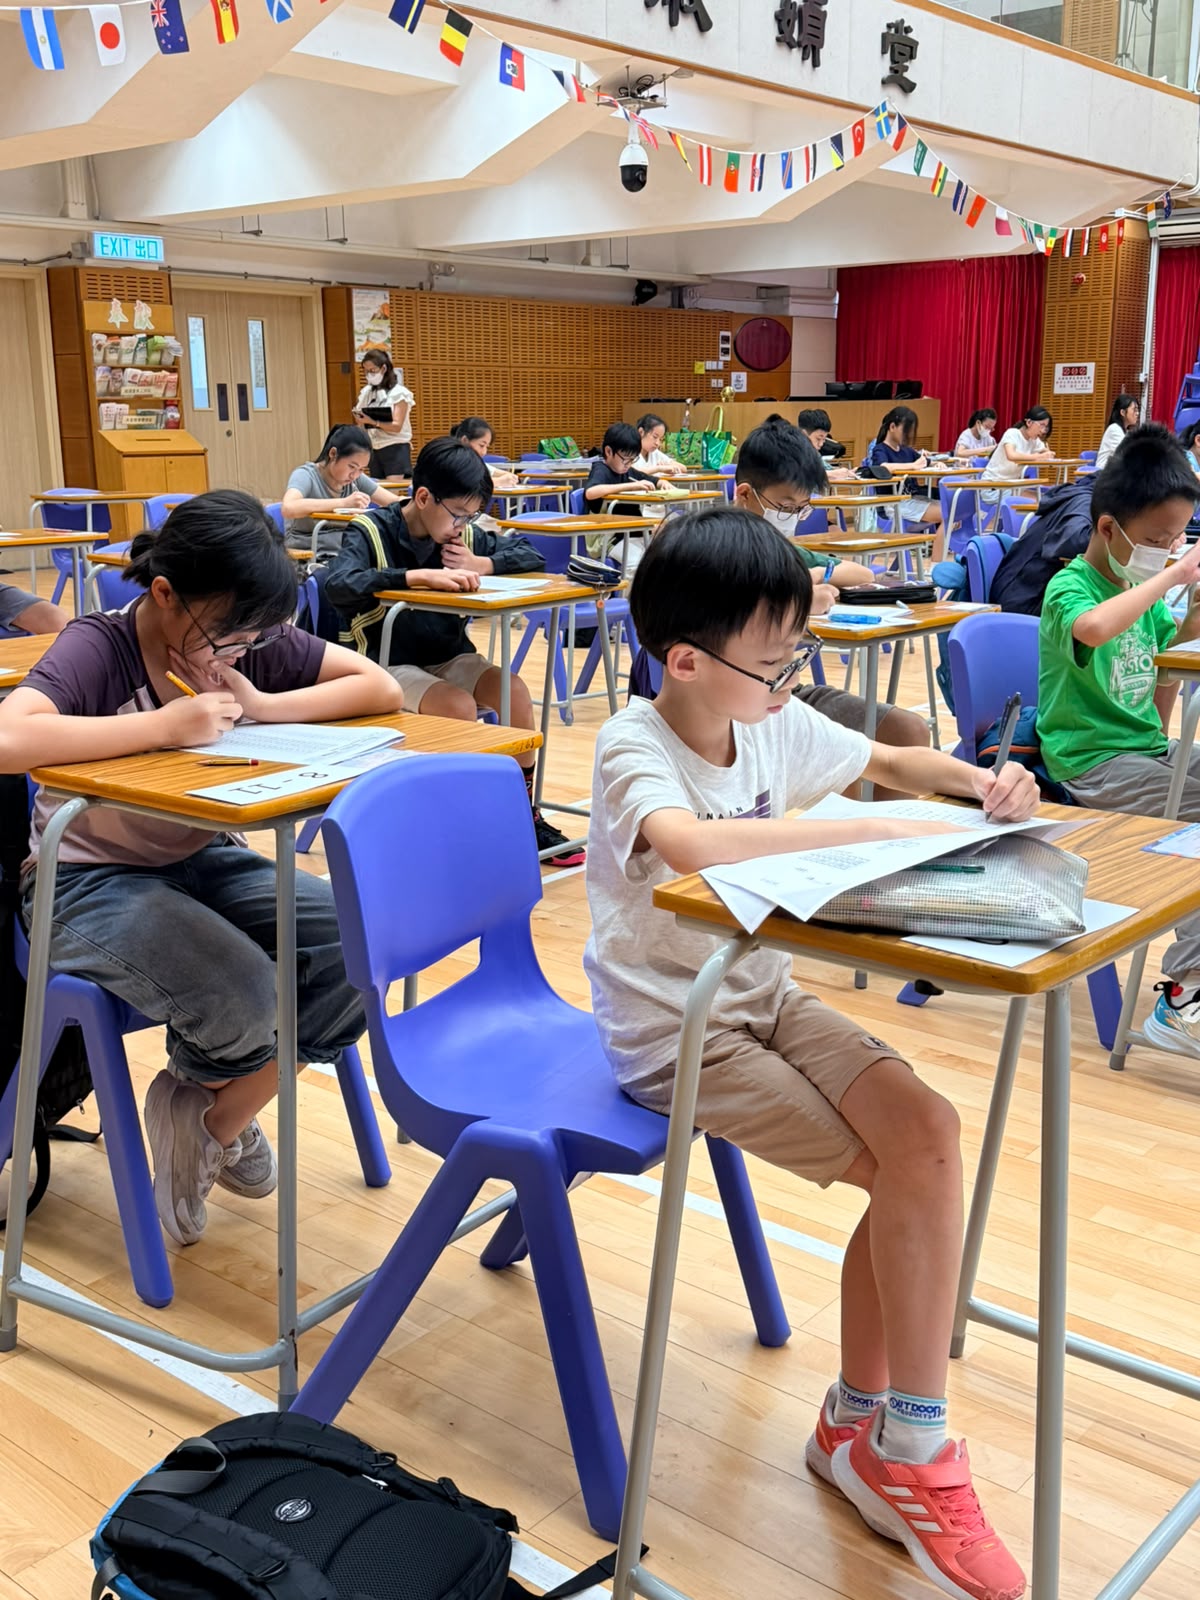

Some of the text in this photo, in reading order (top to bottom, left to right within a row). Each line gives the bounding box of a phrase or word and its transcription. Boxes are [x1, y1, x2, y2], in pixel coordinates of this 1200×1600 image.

[100, 236, 158, 259] EXIT 出口
[896, 1407, 932, 1421] PRODUCTS
